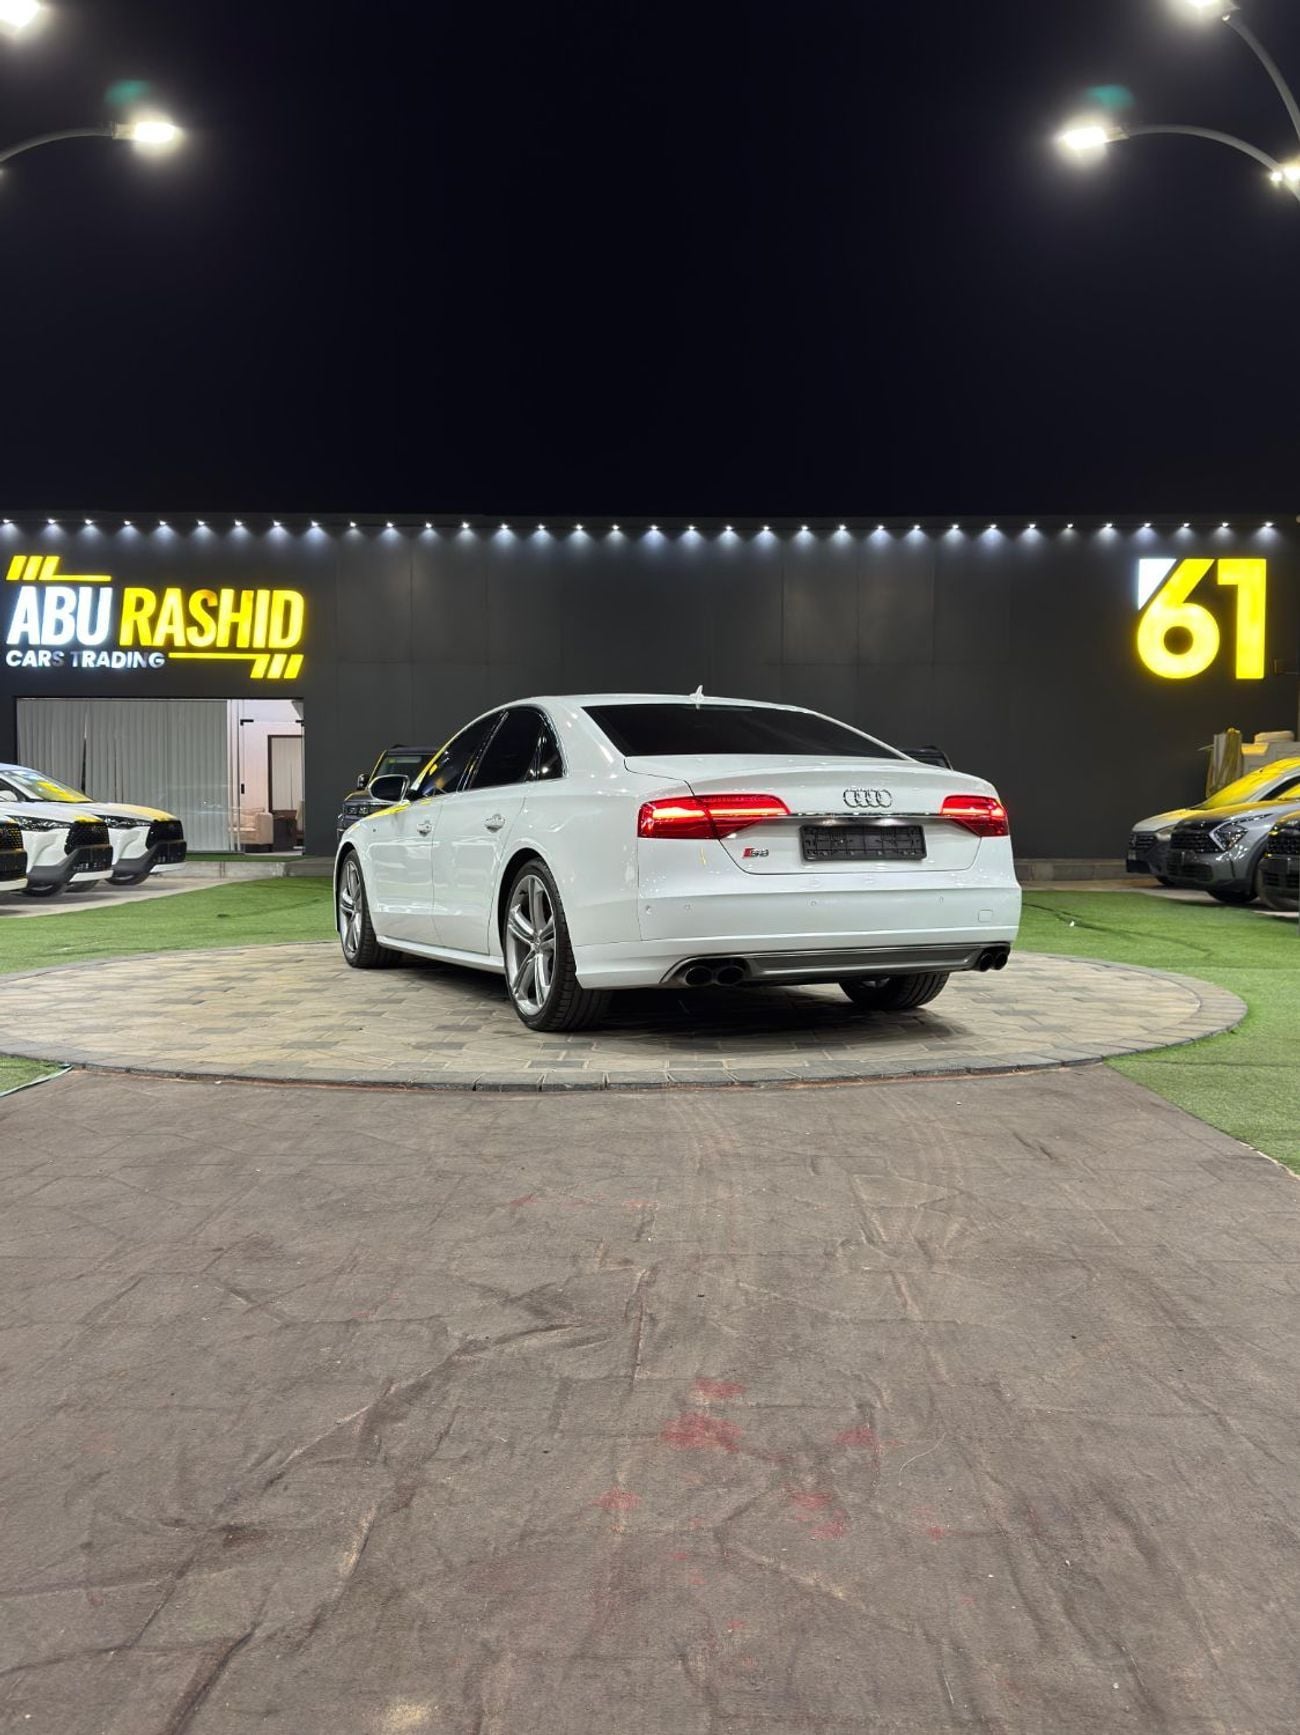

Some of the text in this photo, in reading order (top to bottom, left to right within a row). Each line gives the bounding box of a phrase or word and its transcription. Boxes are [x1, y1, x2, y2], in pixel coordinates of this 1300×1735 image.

[6, 586, 304, 648] ABU RASHID
[1137, 558, 1267, 679] 61
[6, 650, 166, 669] CARS TRADING
